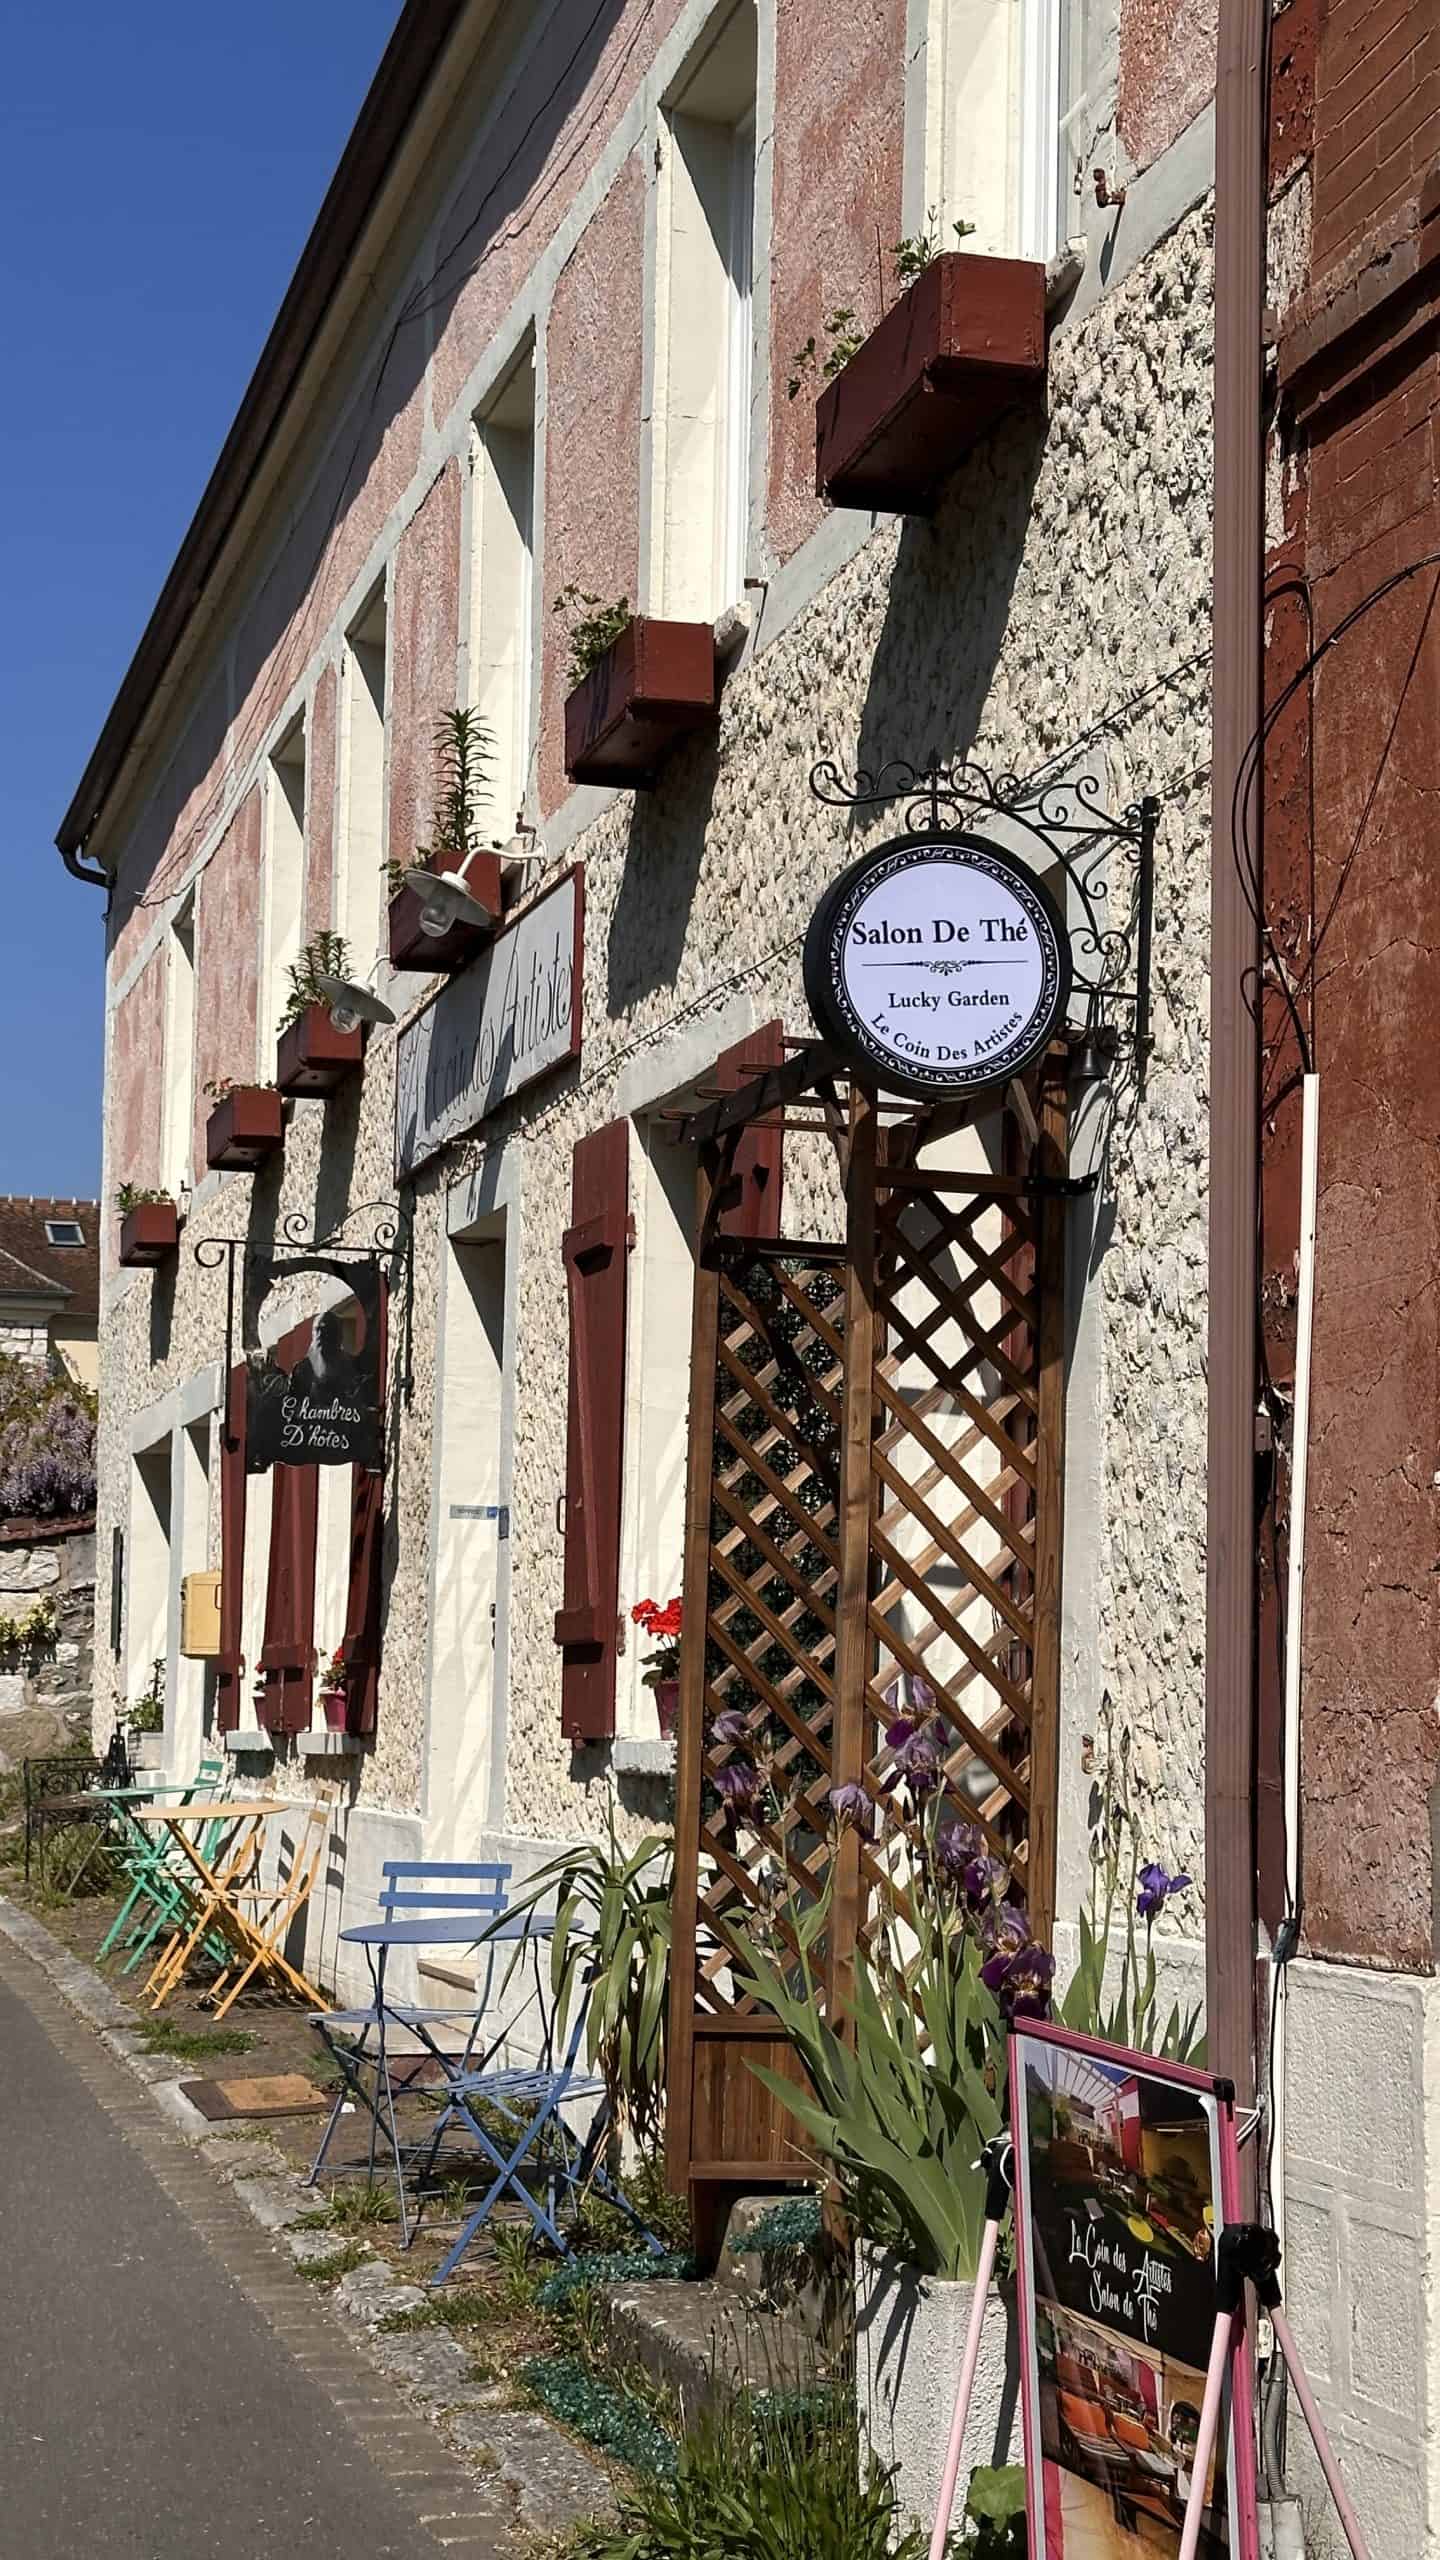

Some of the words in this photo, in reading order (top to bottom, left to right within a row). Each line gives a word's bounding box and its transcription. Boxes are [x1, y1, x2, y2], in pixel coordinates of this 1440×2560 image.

[852, 920, 922, 945] Salon
[932, 919, 970, 943] De
[979, 917, 1029, 942] Thé
[887, 992, 941, 1012] Lucky
[947, 990, 1010, 1007] Garden
[870, 1013, 890, 1035] Le
[893, 1032, 931, 1059] Coin
[936, 1046, 968, 1061] Des
[973, 1011, 1023, 1057] Artistes
[281, 1395, 361, 1424] Chambres
[1069, 2218, 1087, 2263] Le
[1086, 2223, 1110, 2269] Coin
[1113, 2243, 1127, 2273] des
[1132, 2250, 1172, 2296] Artistes
[1090, 2269, 1120, 2313] Salon
[1123, 2291, 1134, 2320] de
[1137, 2294, 1159, 2343] Thé
